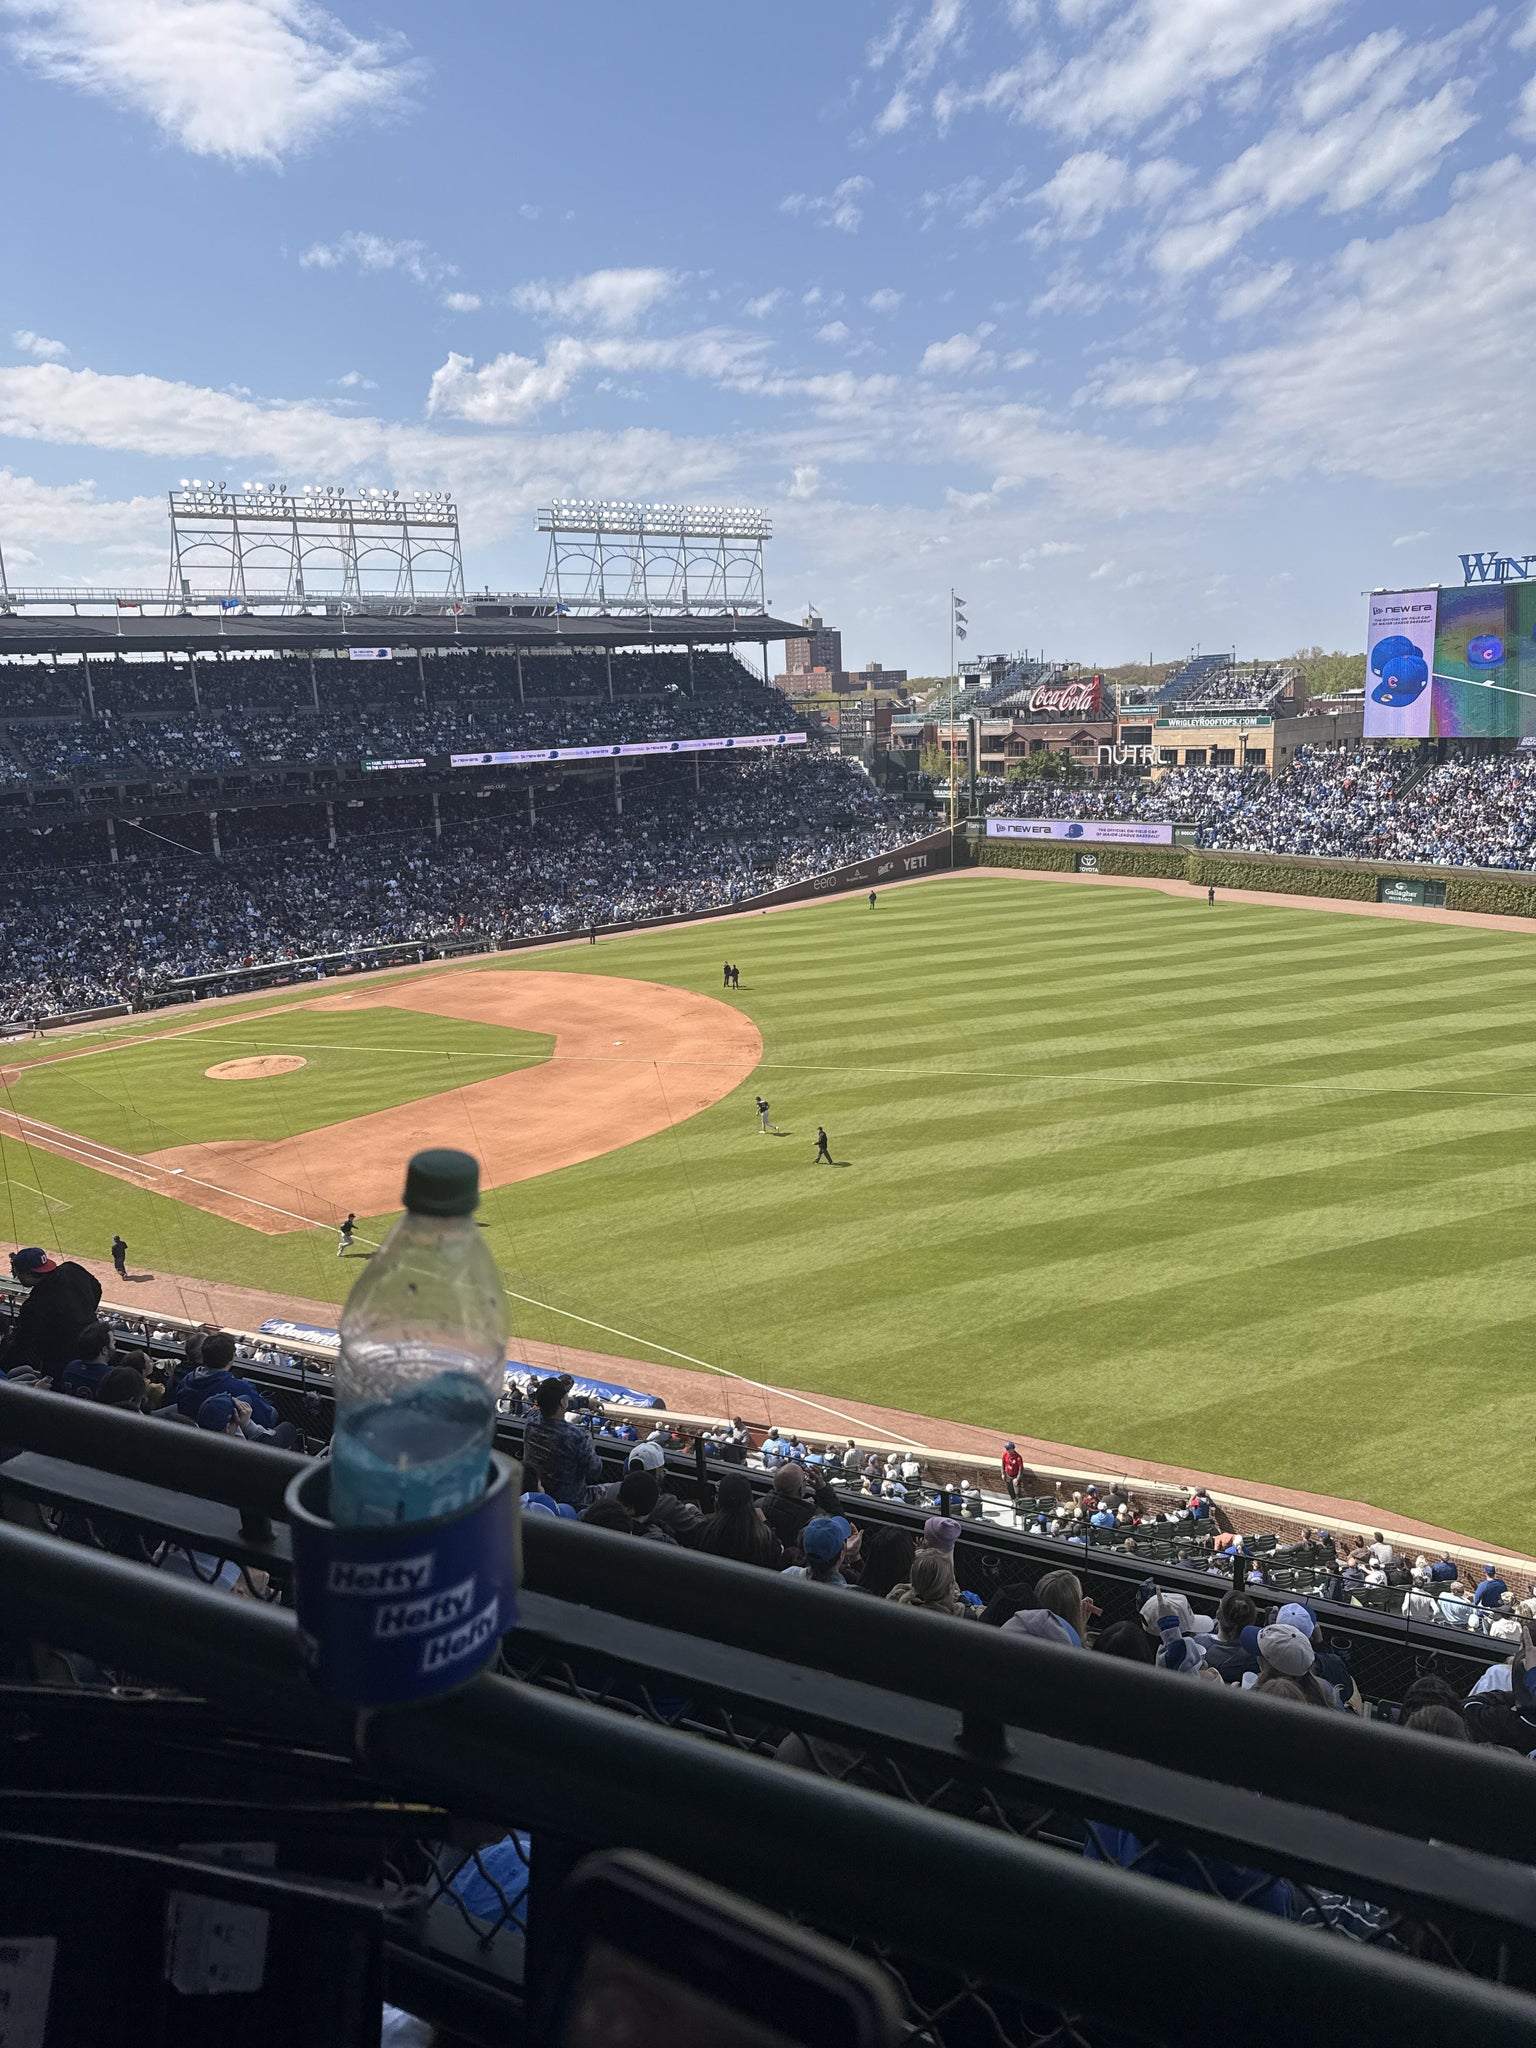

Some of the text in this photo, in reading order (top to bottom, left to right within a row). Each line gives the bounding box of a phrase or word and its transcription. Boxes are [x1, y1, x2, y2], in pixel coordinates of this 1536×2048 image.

[1458, 552, 1536, 583] WIN
[1385, 604, 1432, 613] NEW ERA
[1029, 684, 1095, 712] Coca-Cola
[1007, 825, 1052, 834] NEW ERA
[903, 855, 927, 871] YETI
[813, 876, 837, 890] eero
[1384, 889, 1418, 898] Gallagher
[333, 1560, 428, 1590] Hefty
[379, 1590, 473, 1633] Hefty
[426, 1609, 496, 1665] Hefty
